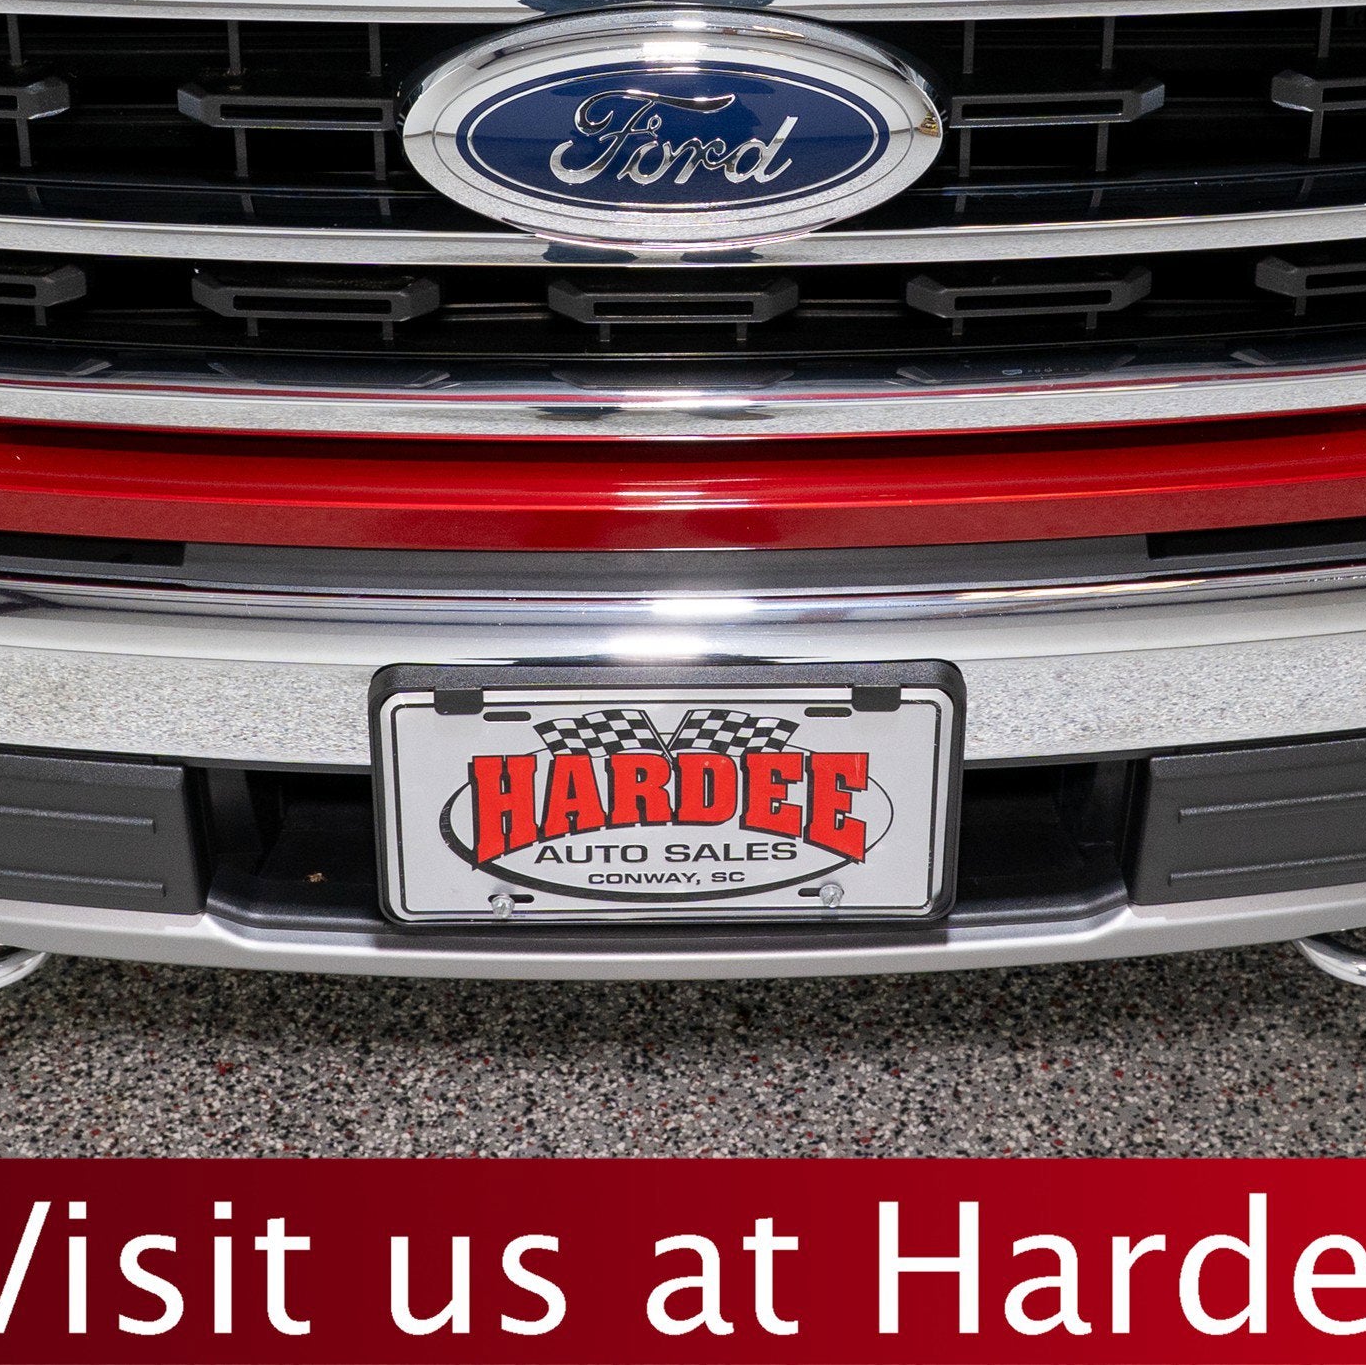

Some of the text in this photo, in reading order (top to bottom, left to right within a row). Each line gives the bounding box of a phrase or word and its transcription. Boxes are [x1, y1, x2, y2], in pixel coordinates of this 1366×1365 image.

[549, 89, 799, 185] Ford
[470, 751, 870, 869] HARDEE
[534, 842, 798, 864] AUTO SALES
[588, 871, 746, 885] CONWAY, SC
